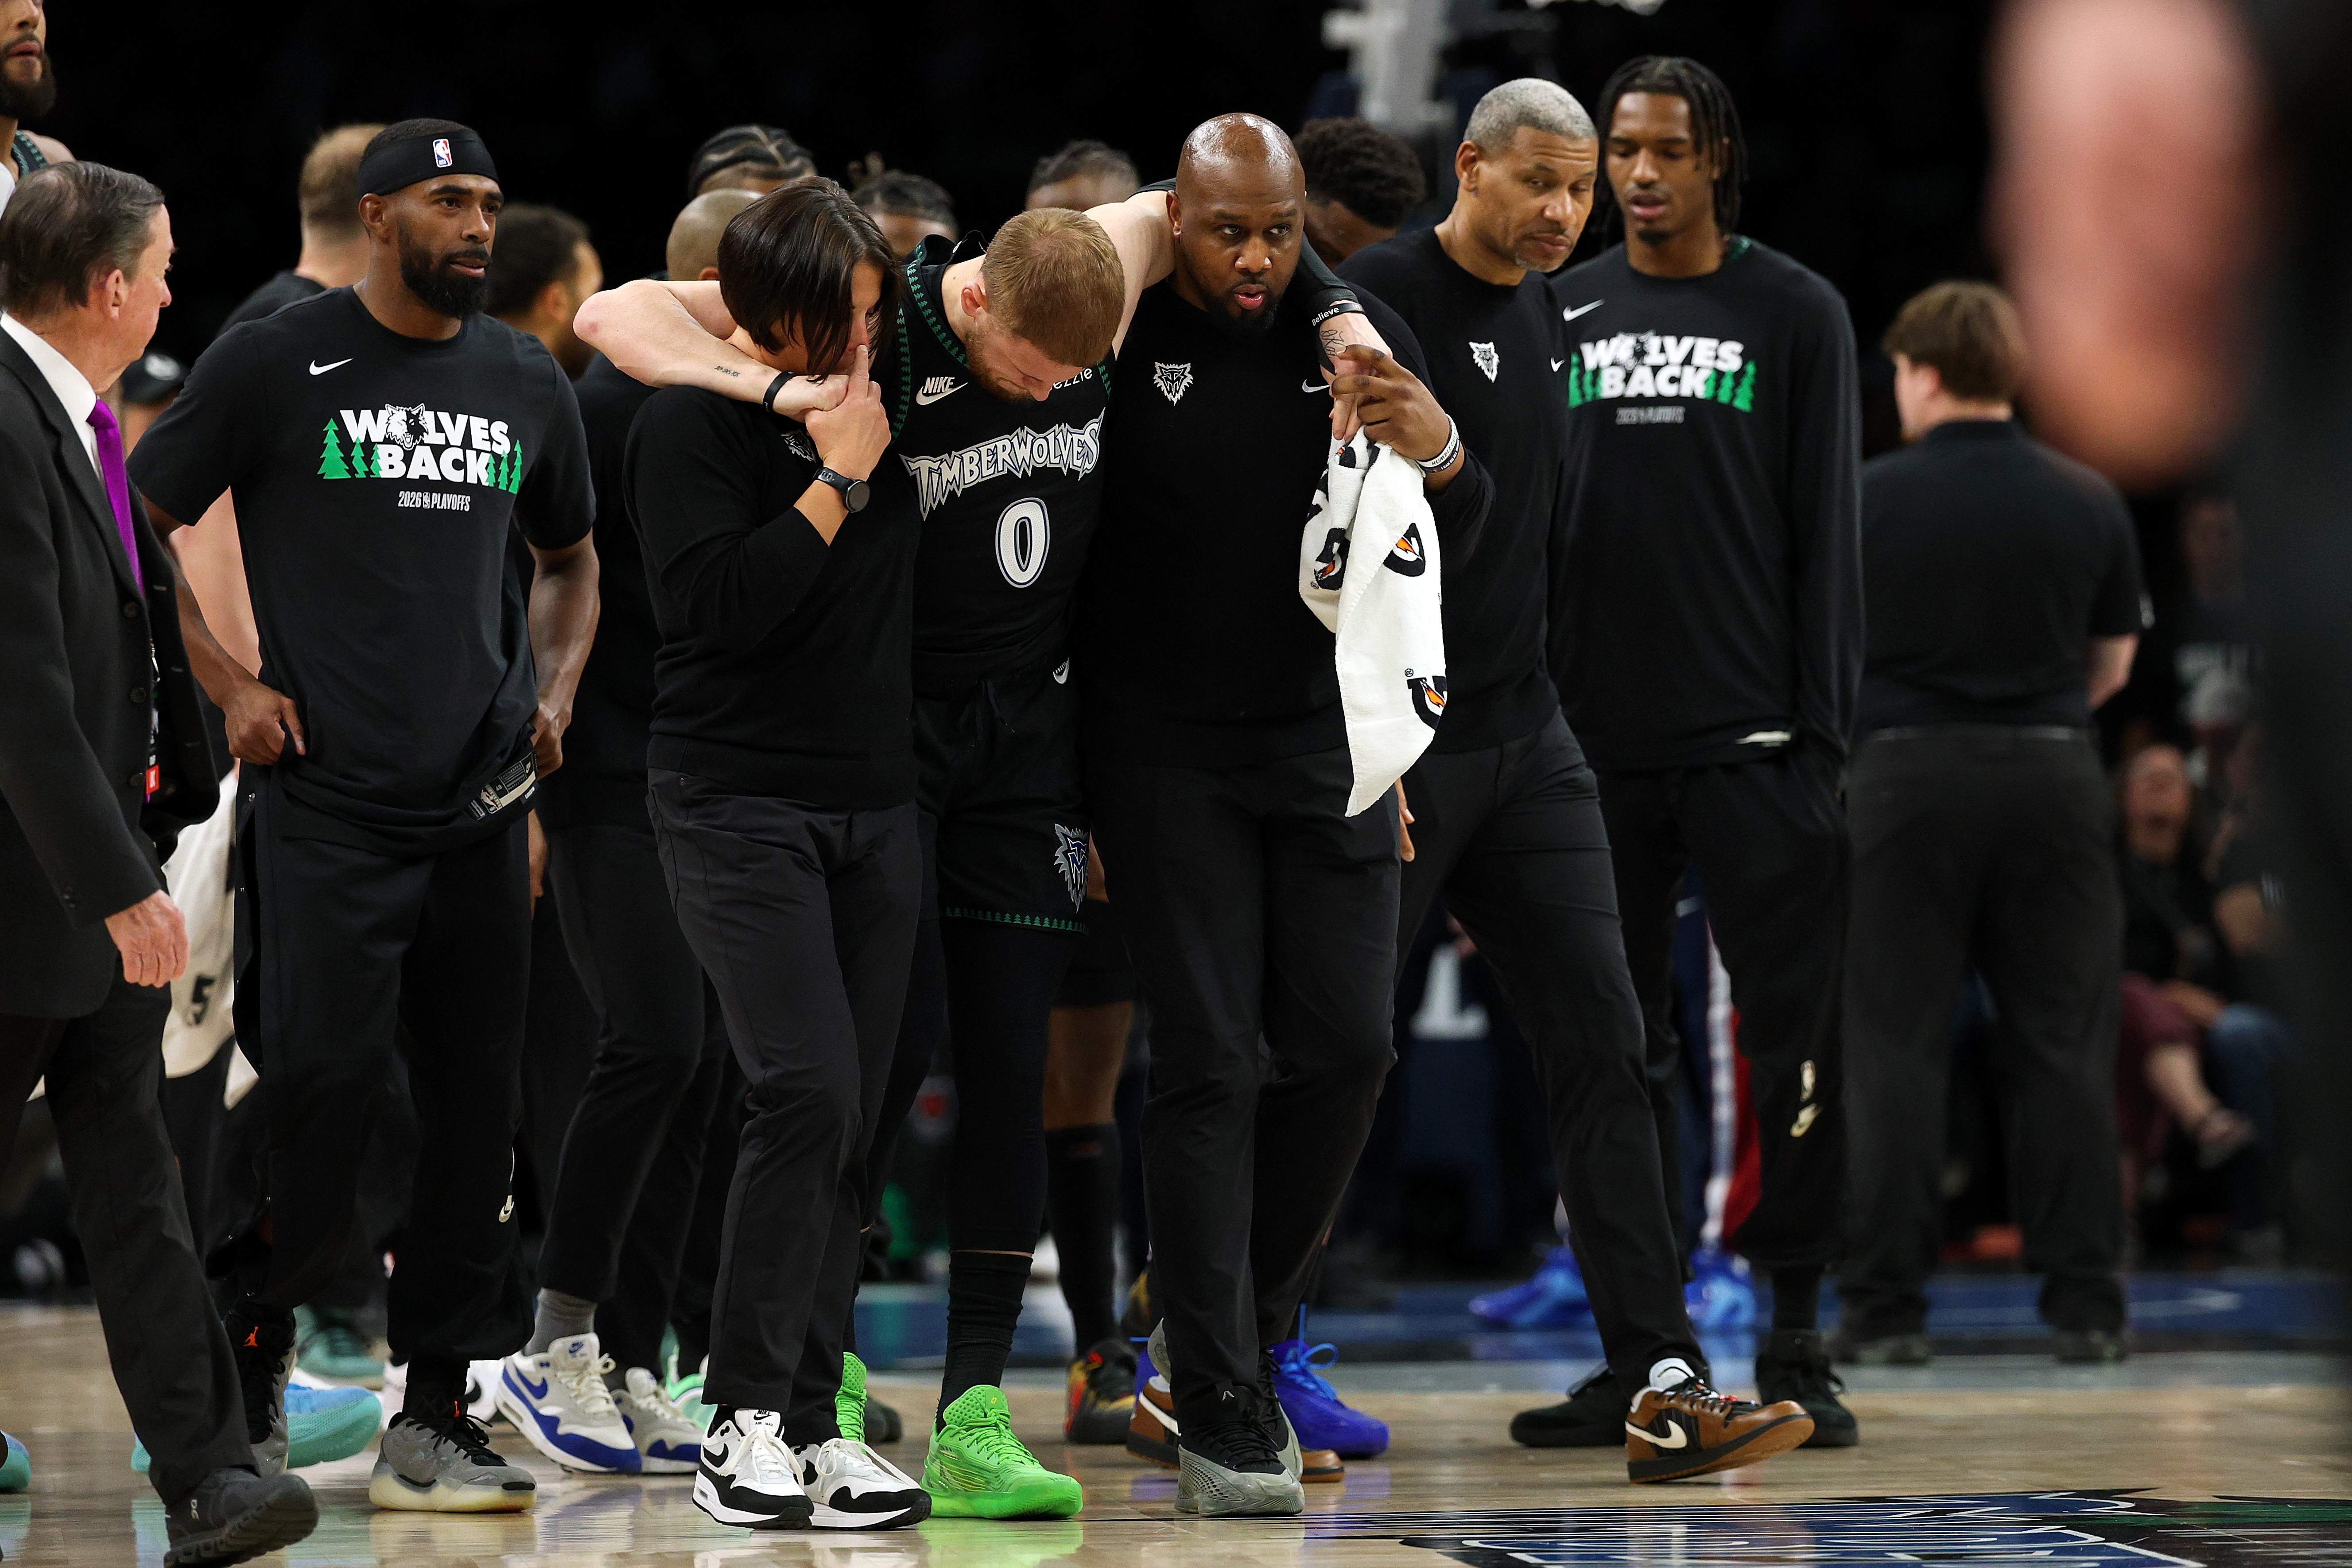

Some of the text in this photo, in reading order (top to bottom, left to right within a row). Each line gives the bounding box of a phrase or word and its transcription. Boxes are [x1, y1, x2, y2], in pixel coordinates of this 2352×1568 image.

[1312, 307, 1339, 326] Believe
[1579, 335, 1744, 373] WLVES
[923, 376, 955, 393] NIKE
[1050, 368, 1093, 391] ezzle
[1600, 365, 1713, 399] BACK
[339, 408, 511, 455] WLVES
[379, 444, 489, 487] BACK
[899, 407, 1106, 521] TIMBERWOLVES
[1432, 446, 1452, 466] HUMBLE
[398, 491, 471, 512] 2026 PLAYOFFS
[995, 497, 1050, 588] 0
